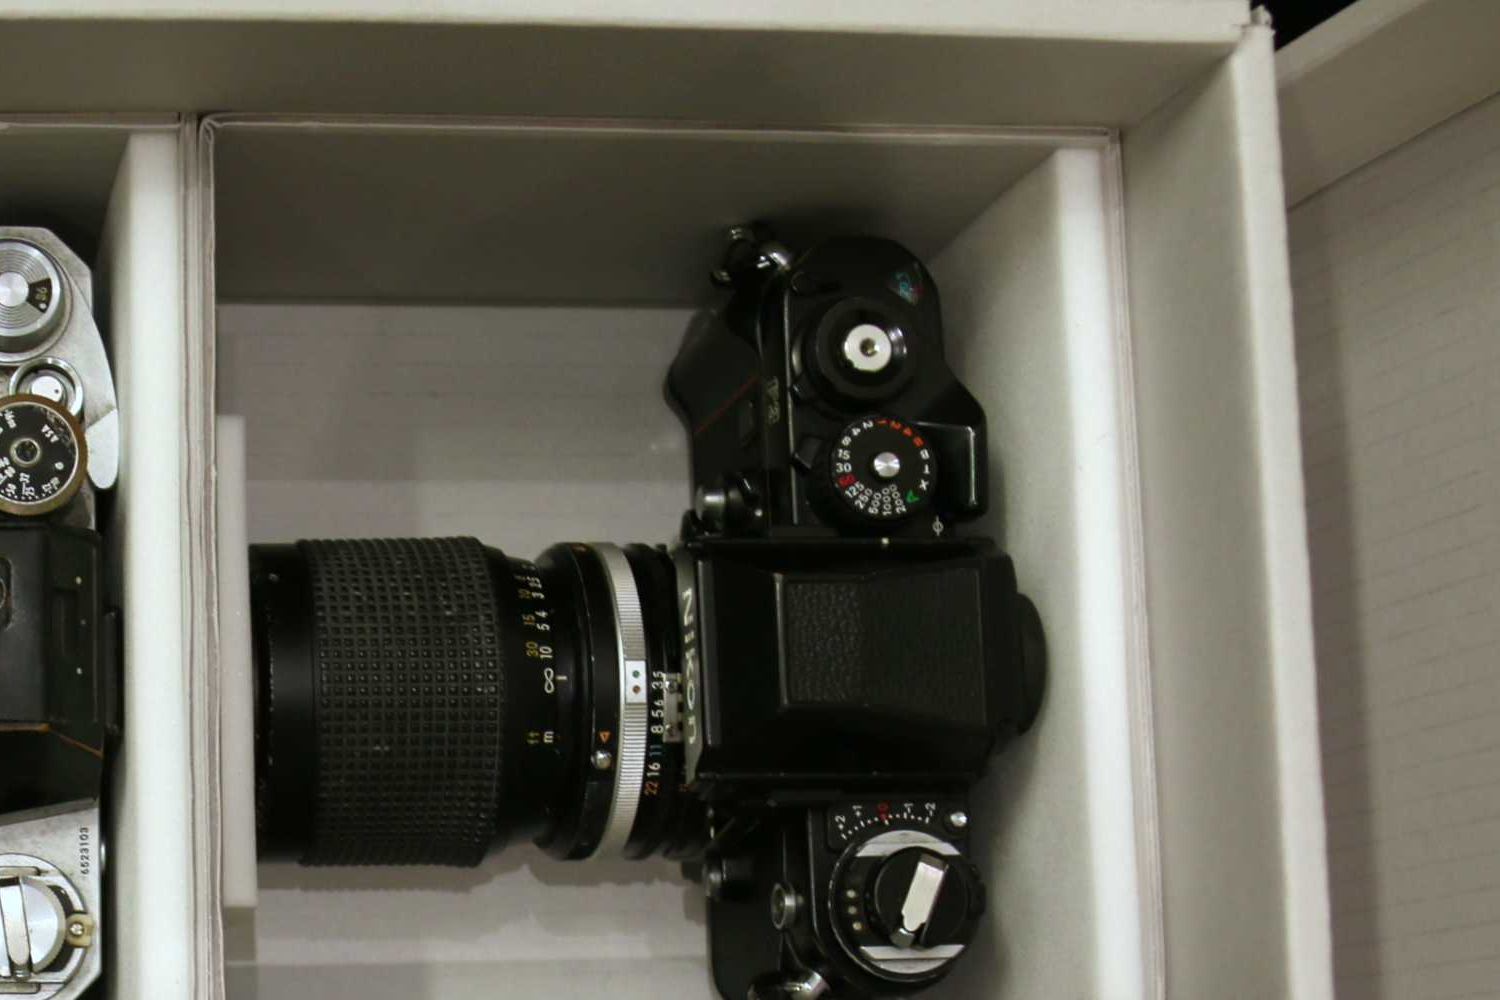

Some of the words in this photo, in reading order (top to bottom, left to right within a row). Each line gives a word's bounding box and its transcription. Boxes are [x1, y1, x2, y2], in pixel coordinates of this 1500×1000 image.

[837, 448, 851, 460] 15
[836, 462, 852, 473] 30
[845, 481, 864, 498] 125
[855, 488, 873, 509] 250
[868, 492, 882, 514] 500
[882, 488, 892, 515] 1000
[889, 484, 907, 514] 2000
[536, 623, 550, 631] 5
[526, 641, 539, 658] 30
[539, 646, 553, 659] 10
[650, 724, 664, 734] 8
[647, 761, 661, 777] 16
